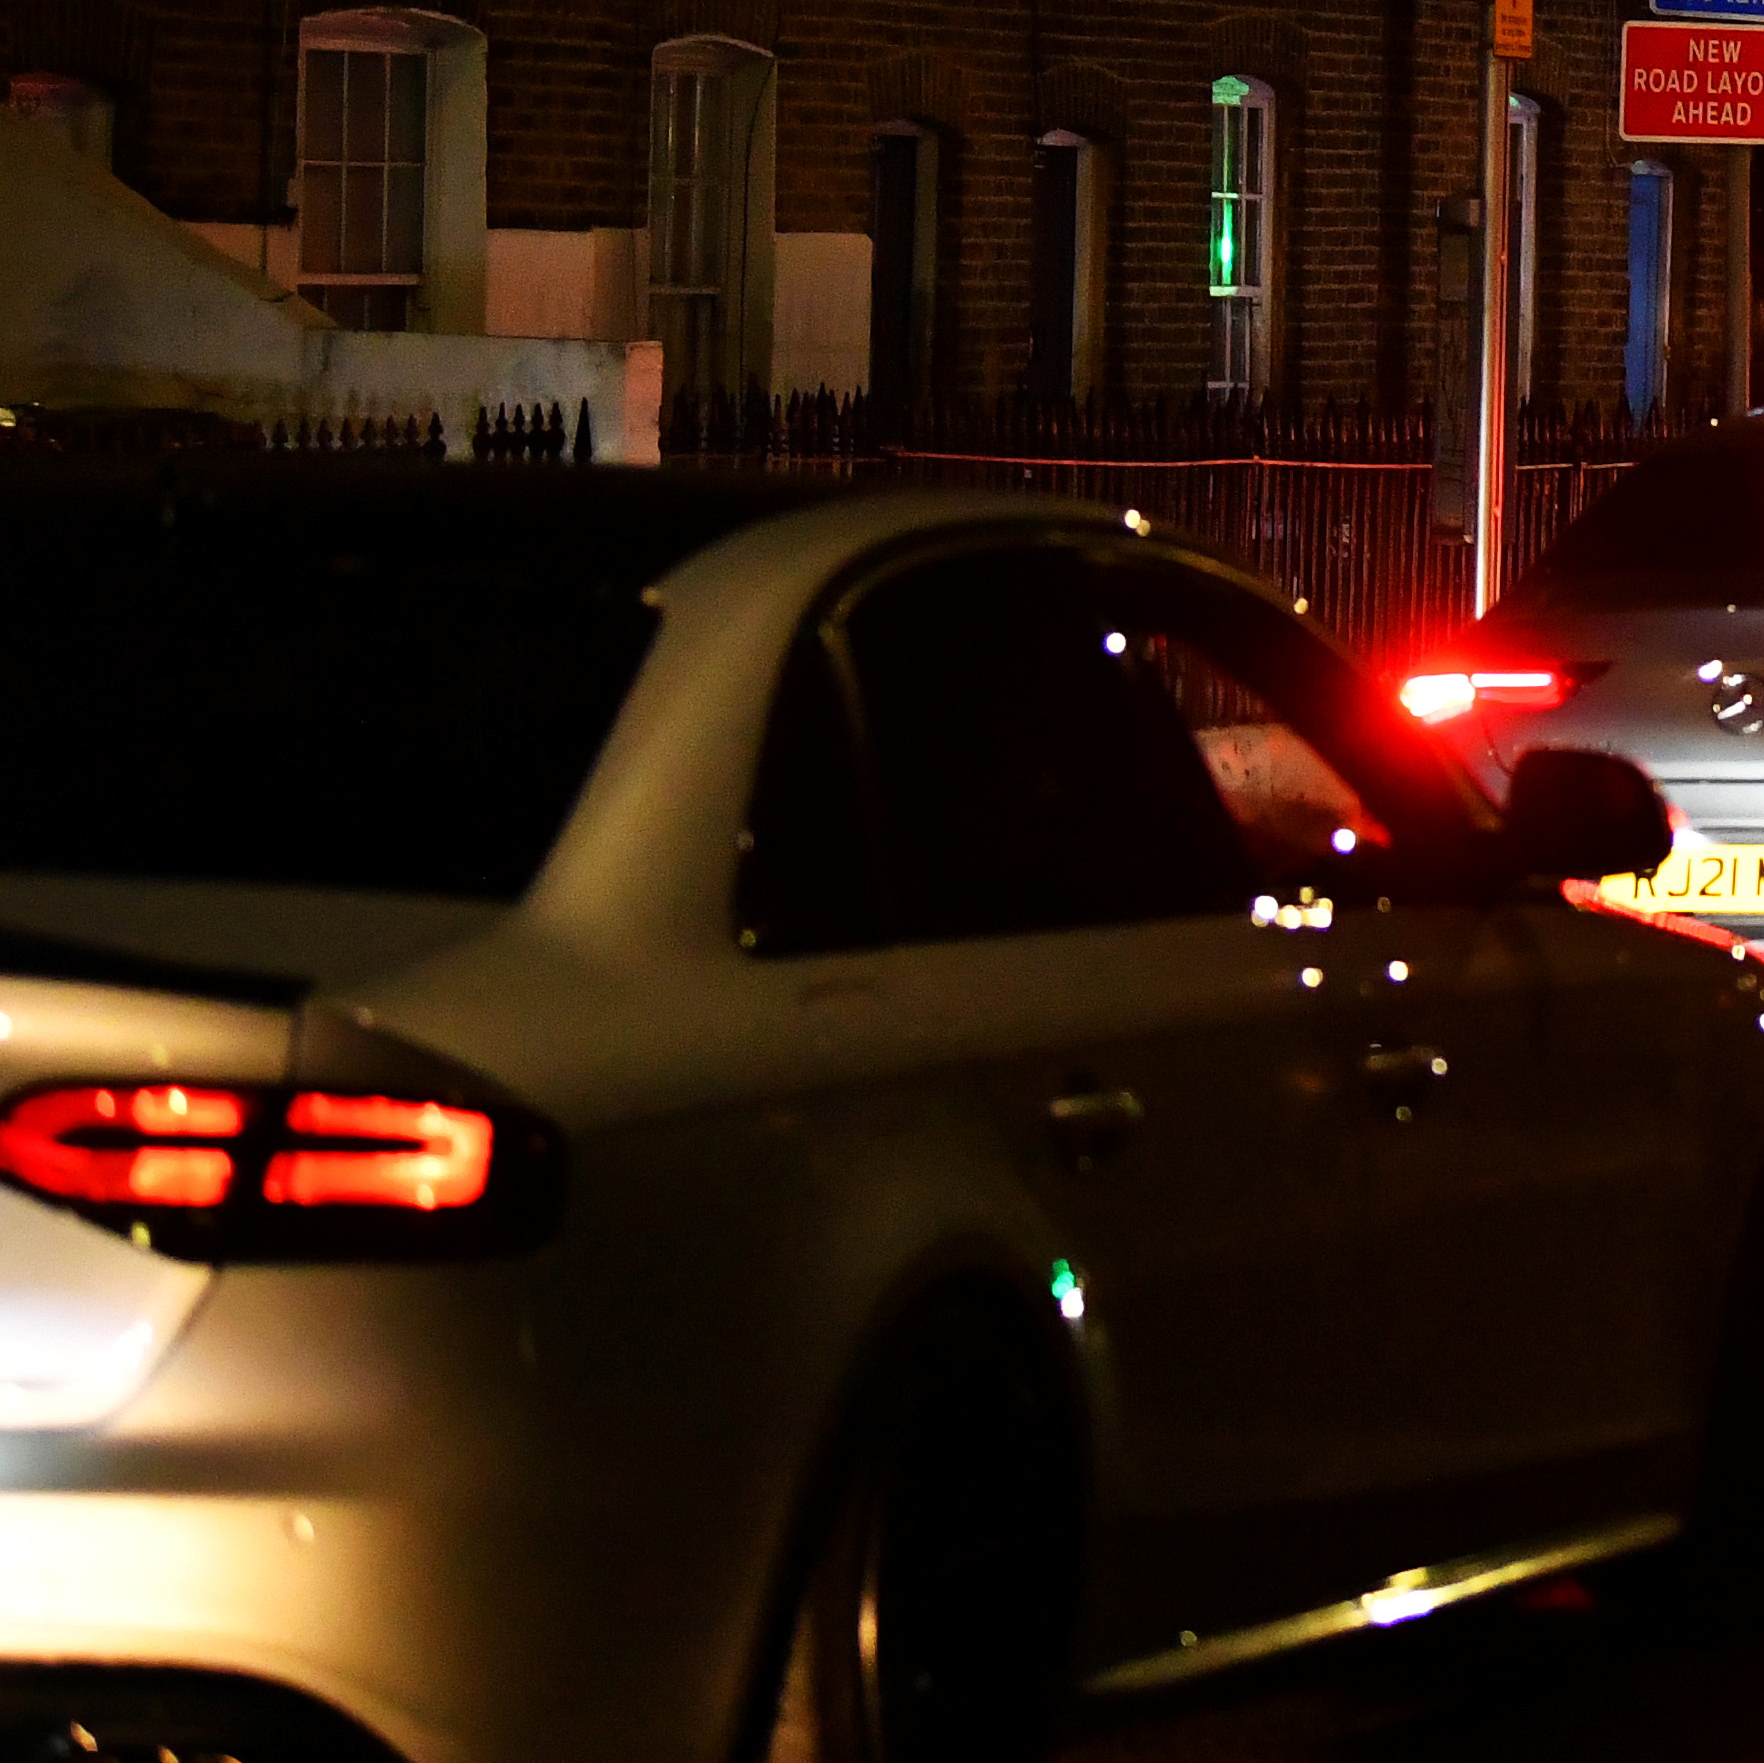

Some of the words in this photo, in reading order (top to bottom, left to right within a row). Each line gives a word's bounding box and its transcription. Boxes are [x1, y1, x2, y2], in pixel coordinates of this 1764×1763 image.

[1688, 38, 1741, 64] NEW
[1634, 68, 1698, 93] ROAD
[1671, 101, 1751, 126] AHEAD
